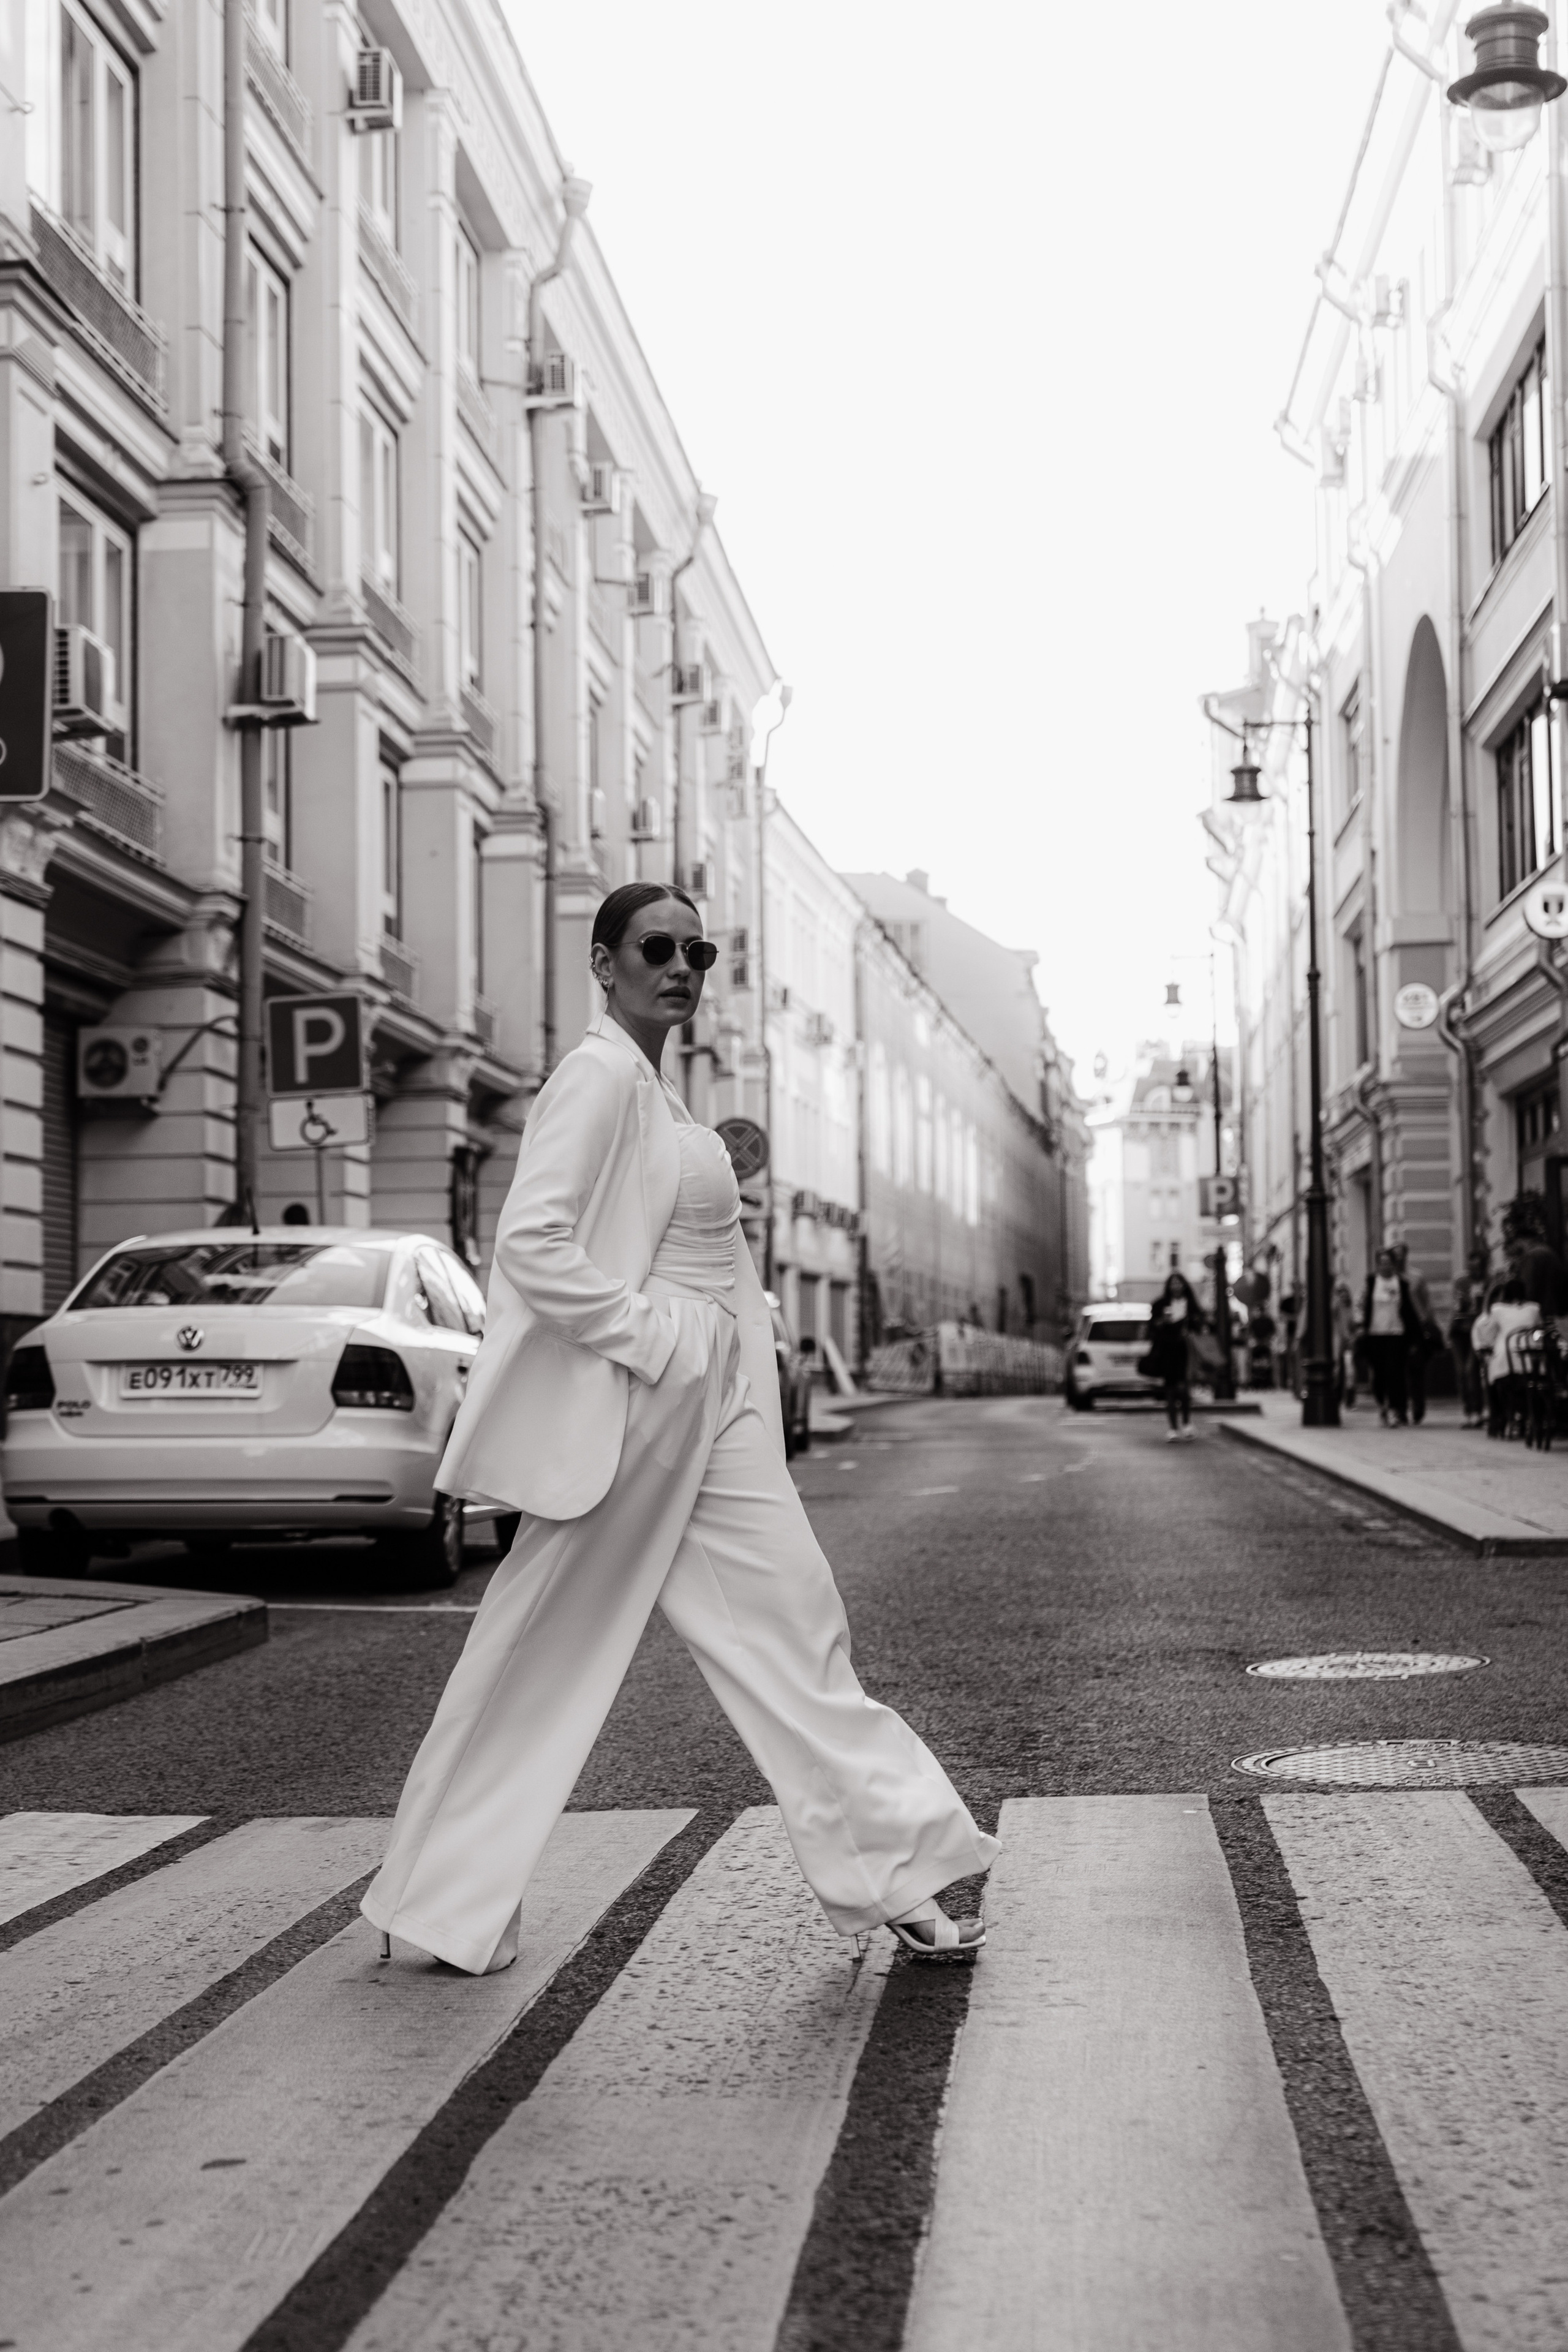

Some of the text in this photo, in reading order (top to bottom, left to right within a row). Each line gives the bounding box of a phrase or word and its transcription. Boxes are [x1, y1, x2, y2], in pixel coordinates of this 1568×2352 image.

[293, 1007, 345, 1084] P
[1208, 1179, 1234, 1213] P
[219, 1364, 255, 1384] 799
